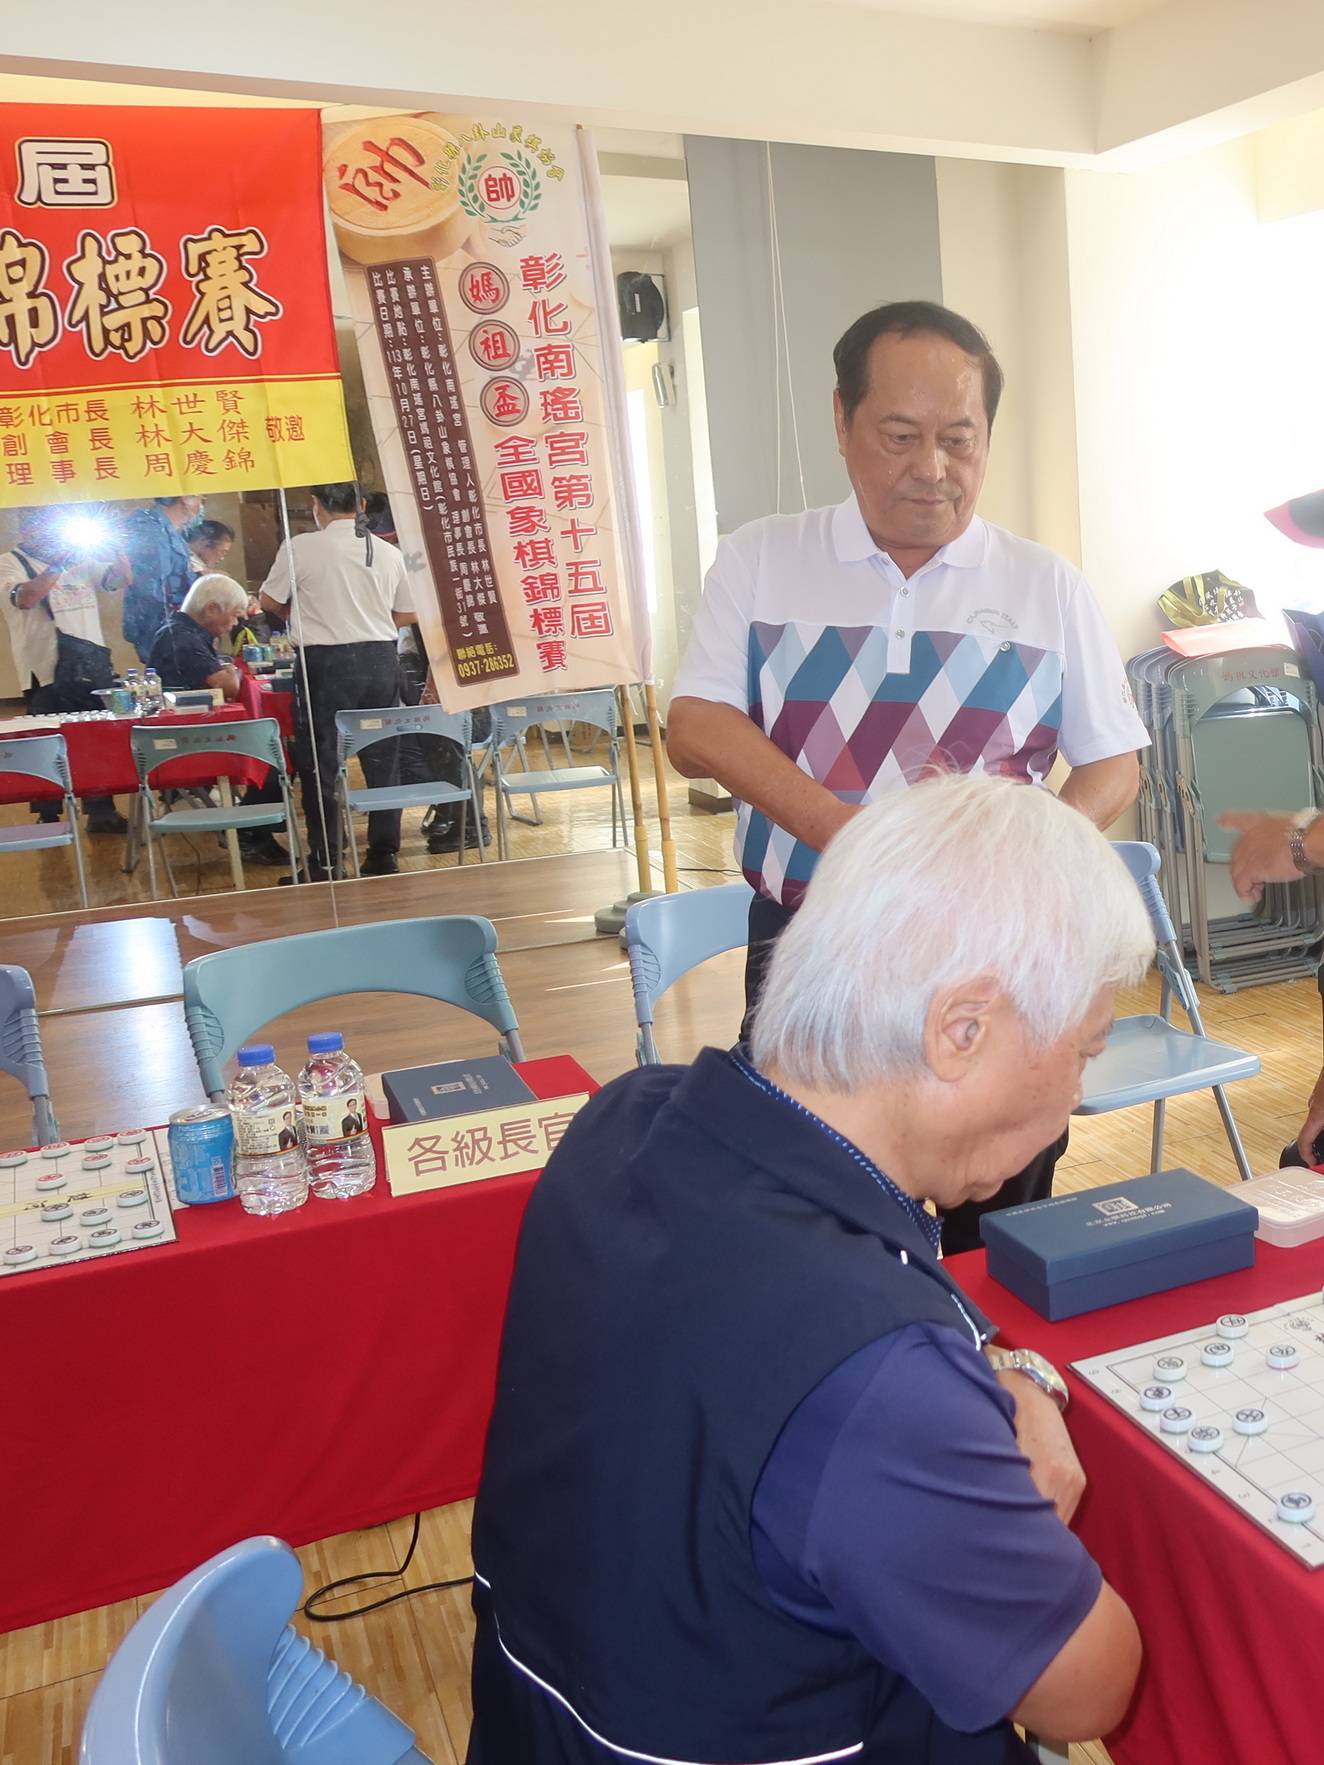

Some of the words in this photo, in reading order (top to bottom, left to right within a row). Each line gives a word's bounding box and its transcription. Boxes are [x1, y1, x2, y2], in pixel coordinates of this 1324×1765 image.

[14, 137, 117, 208] 屆
[484, 173, 516, 203] 帥
[0, 399, 110, 429] 彰化市長
[130, 389, 245, 420] 林世賢
[1, 427, 115, 457] 創會長
[135, 419, 250, 448] 林大傑
[265, 414, 306, 443] 敬邀
[6, 457, 121, 486] 理事長
[144, 448, 256, 478] 周慶錦
[458, 653, 515, 678] 0937-286352
